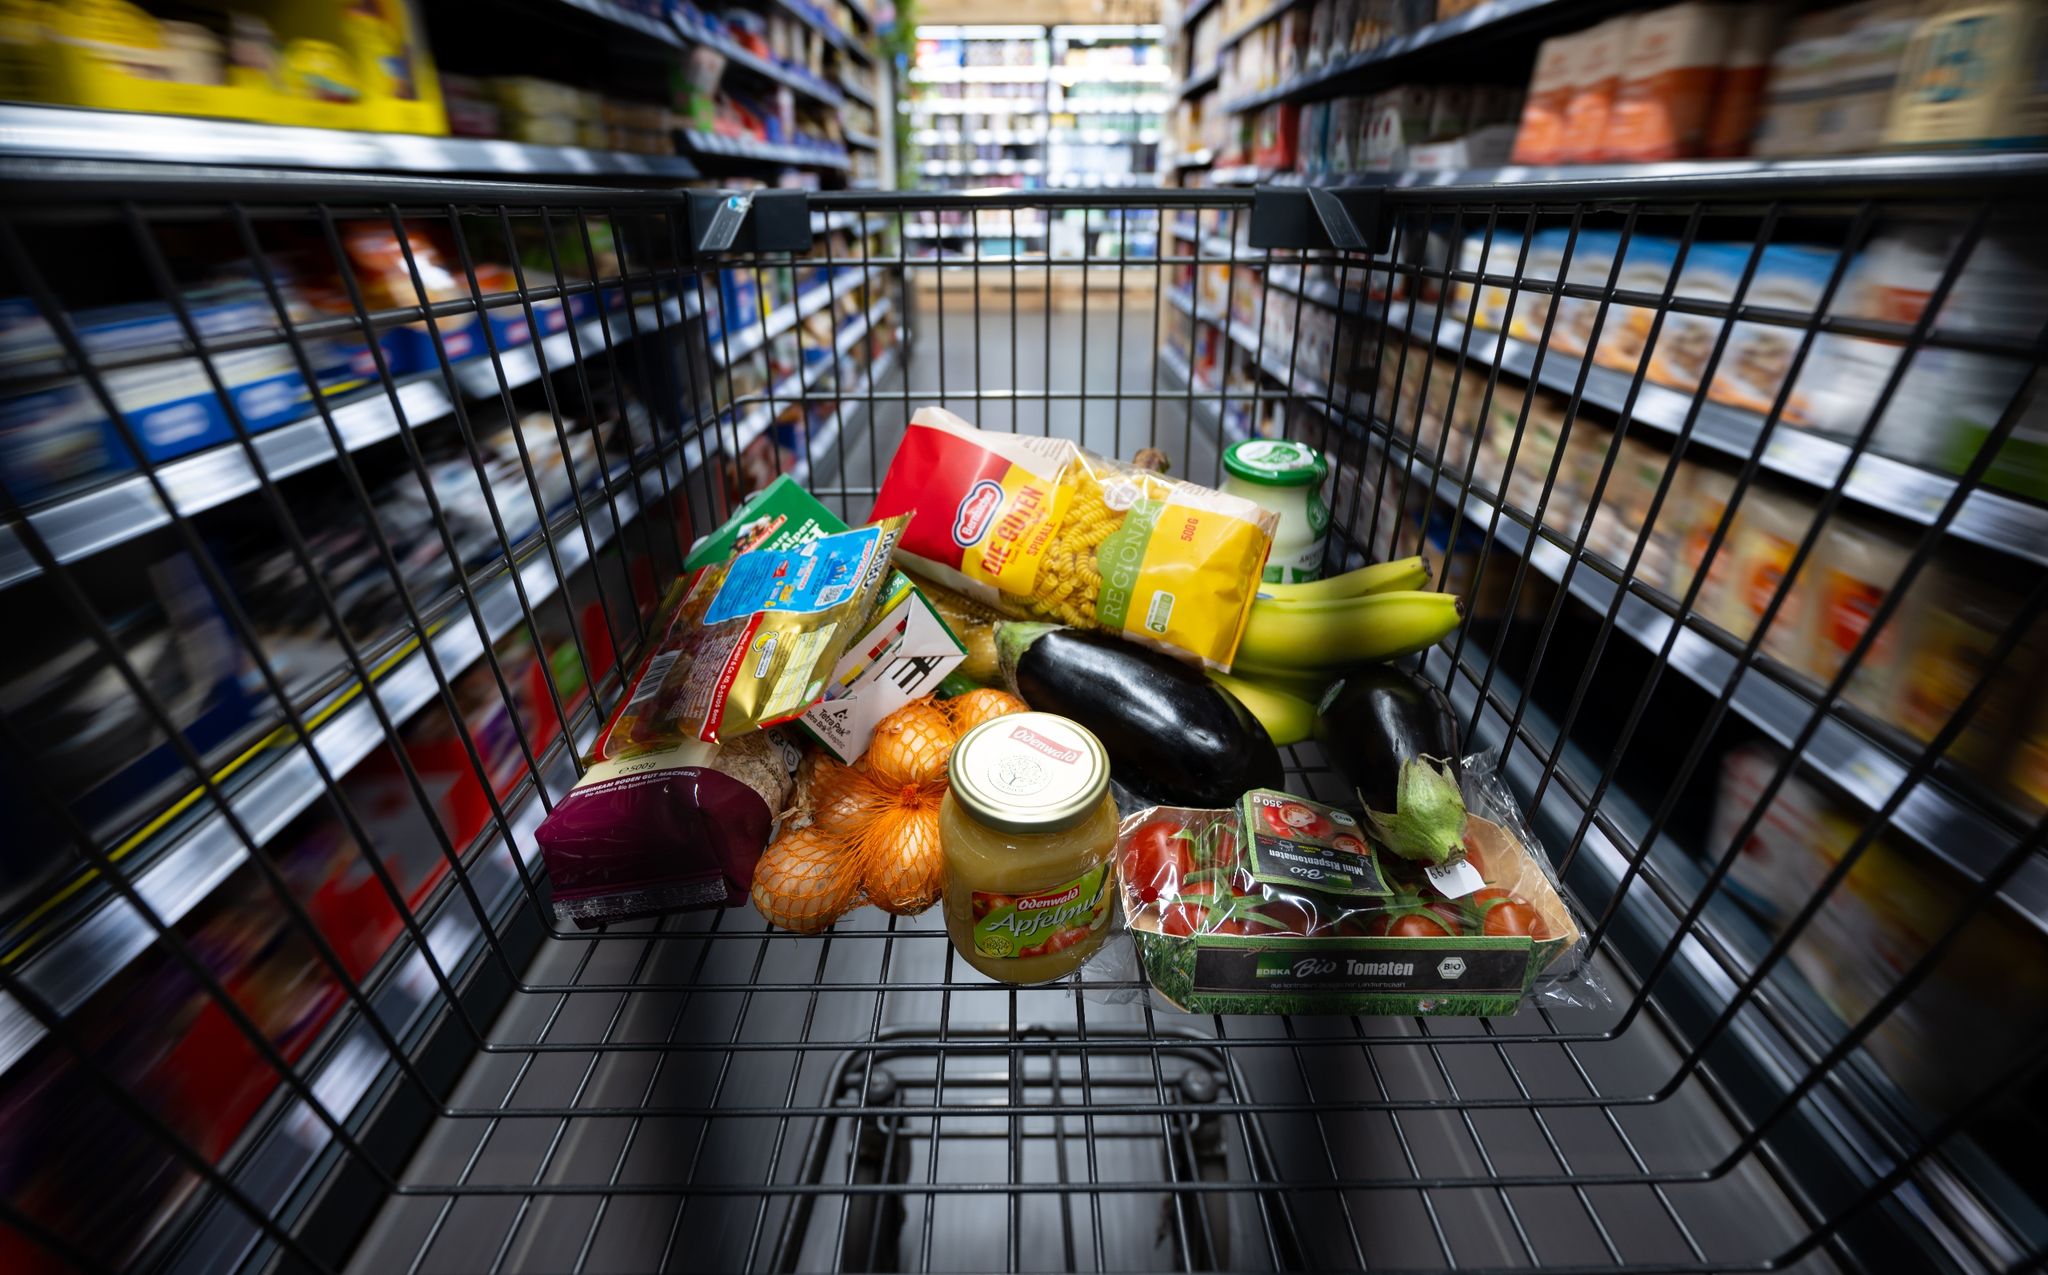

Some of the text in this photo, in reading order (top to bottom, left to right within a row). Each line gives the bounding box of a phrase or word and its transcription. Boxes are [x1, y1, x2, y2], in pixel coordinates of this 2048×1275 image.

[981, 541, 1013, 577] DIE
[997, 485, 1044, 543] GUTEN
[1026, 522, 1057, 557] SPIRALE
[805, 710, 819, 724] Tetra
[818, 709, 835, 726] Tetra
[1013, 729, 1078, 763] Odenwald
[570, 782, 614, 798] GEMEINSAM
[615, 775, 641, 786] BODEN
[1263, 798, 1283, 808] 350
[1269, 848, 1341, 872] Rispentomaten
[1343, 862, 1364, 876] Mini
[1290, 866, 1325, 880] Bio
[1018, 888, 1079, 911] Odenwald
[1256, 958, 1414, 978] EDEKA Bio Tomaten
